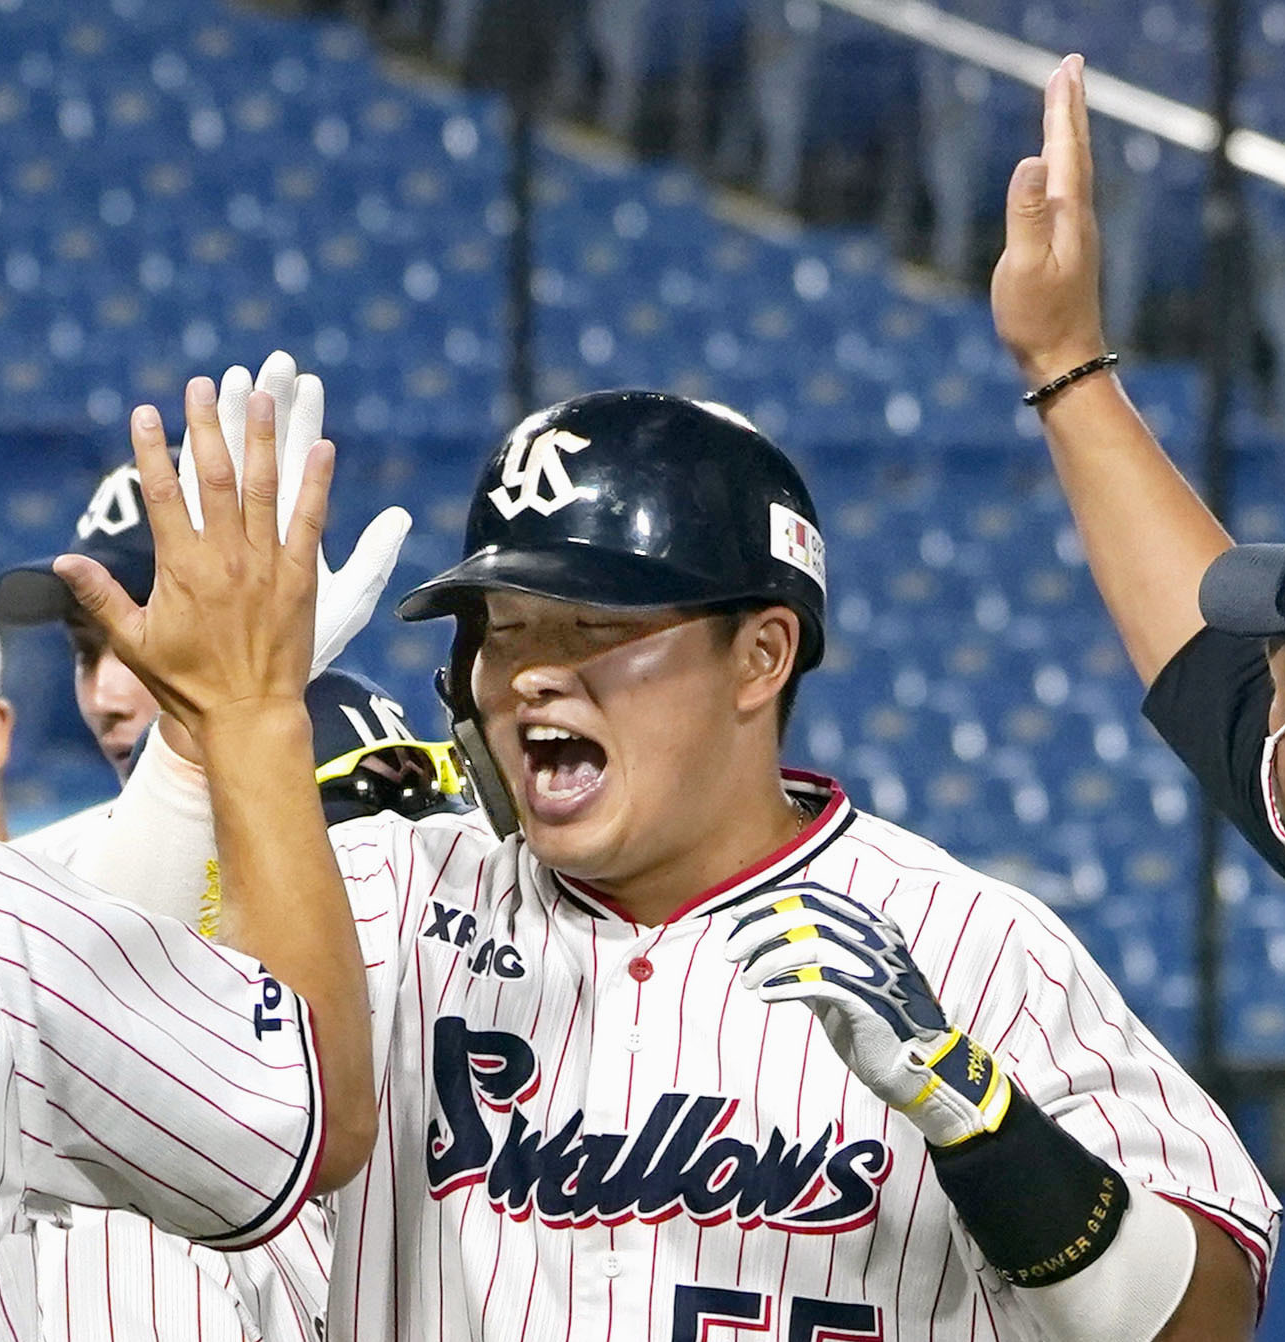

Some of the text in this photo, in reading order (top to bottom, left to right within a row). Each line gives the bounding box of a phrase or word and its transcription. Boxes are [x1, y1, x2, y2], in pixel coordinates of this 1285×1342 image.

[428, 1016, 894, 1235] Swallows
[1019, 1176, 1116, 1282] POWER GEAR
